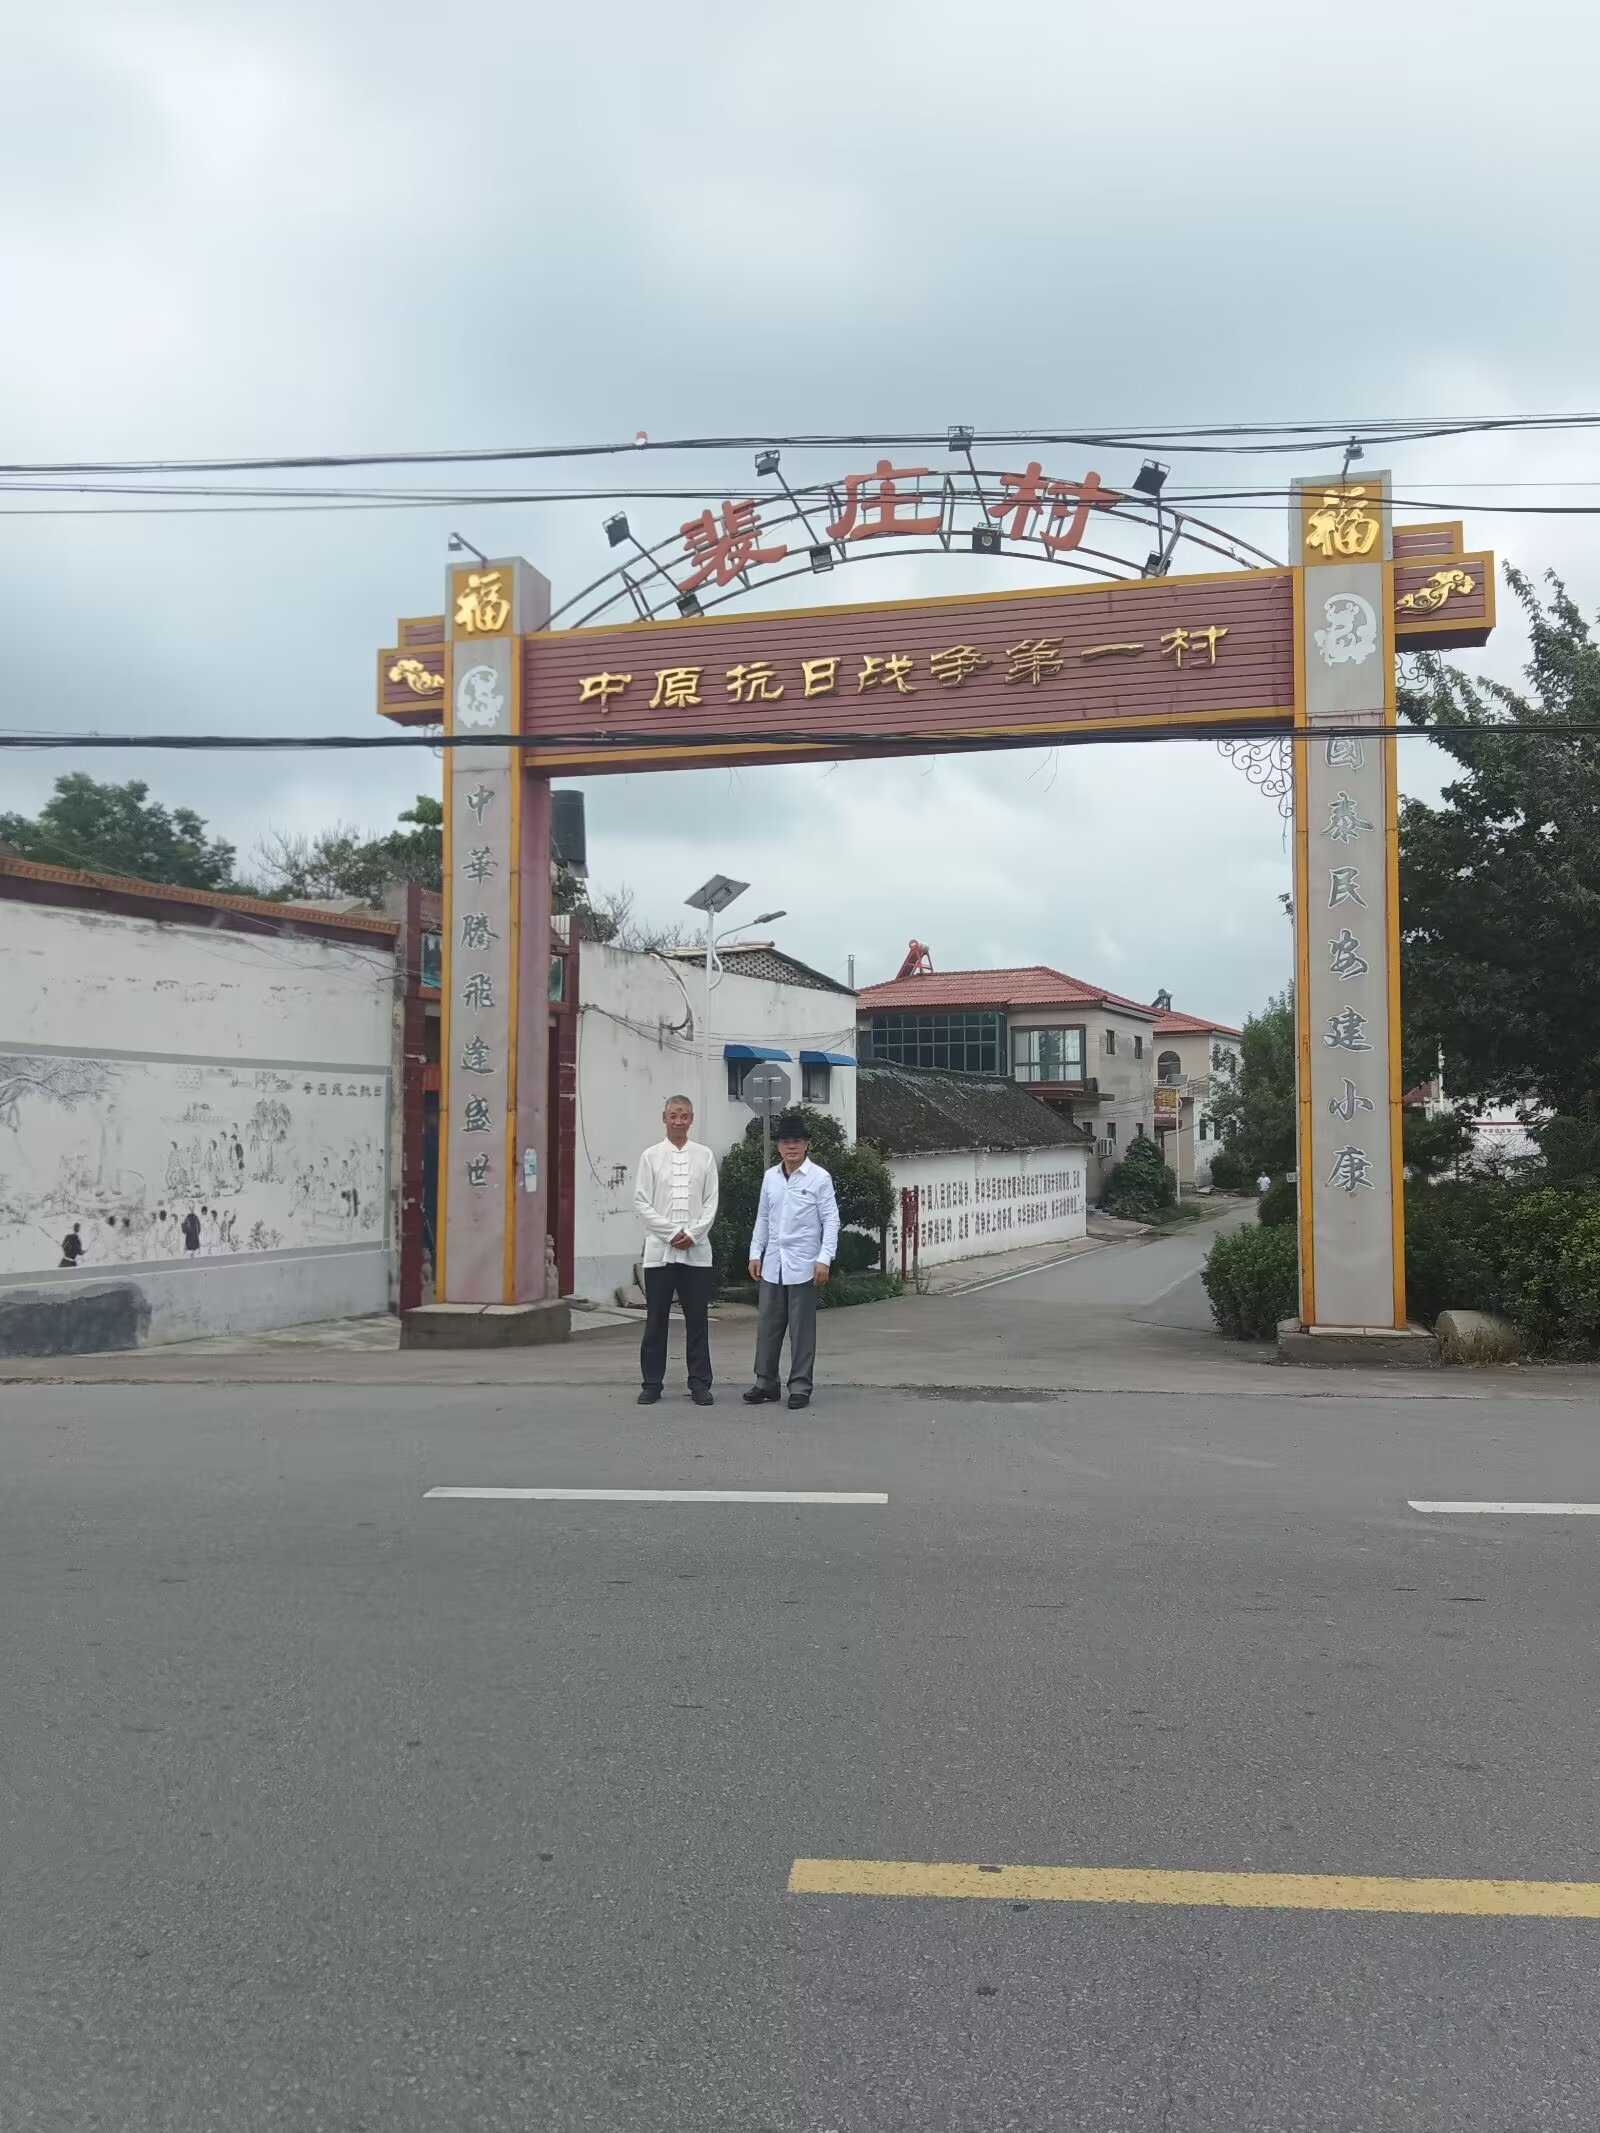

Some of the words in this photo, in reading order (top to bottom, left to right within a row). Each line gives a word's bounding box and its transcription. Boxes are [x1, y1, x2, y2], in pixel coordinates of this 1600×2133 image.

[678, 460, 1121, 592] 裴庄村
[1306, 486, 1380, 556] 福
[454, 571, 511, 633] 福
[579, 625, 1229, 714] 中原抗日战争第一村
